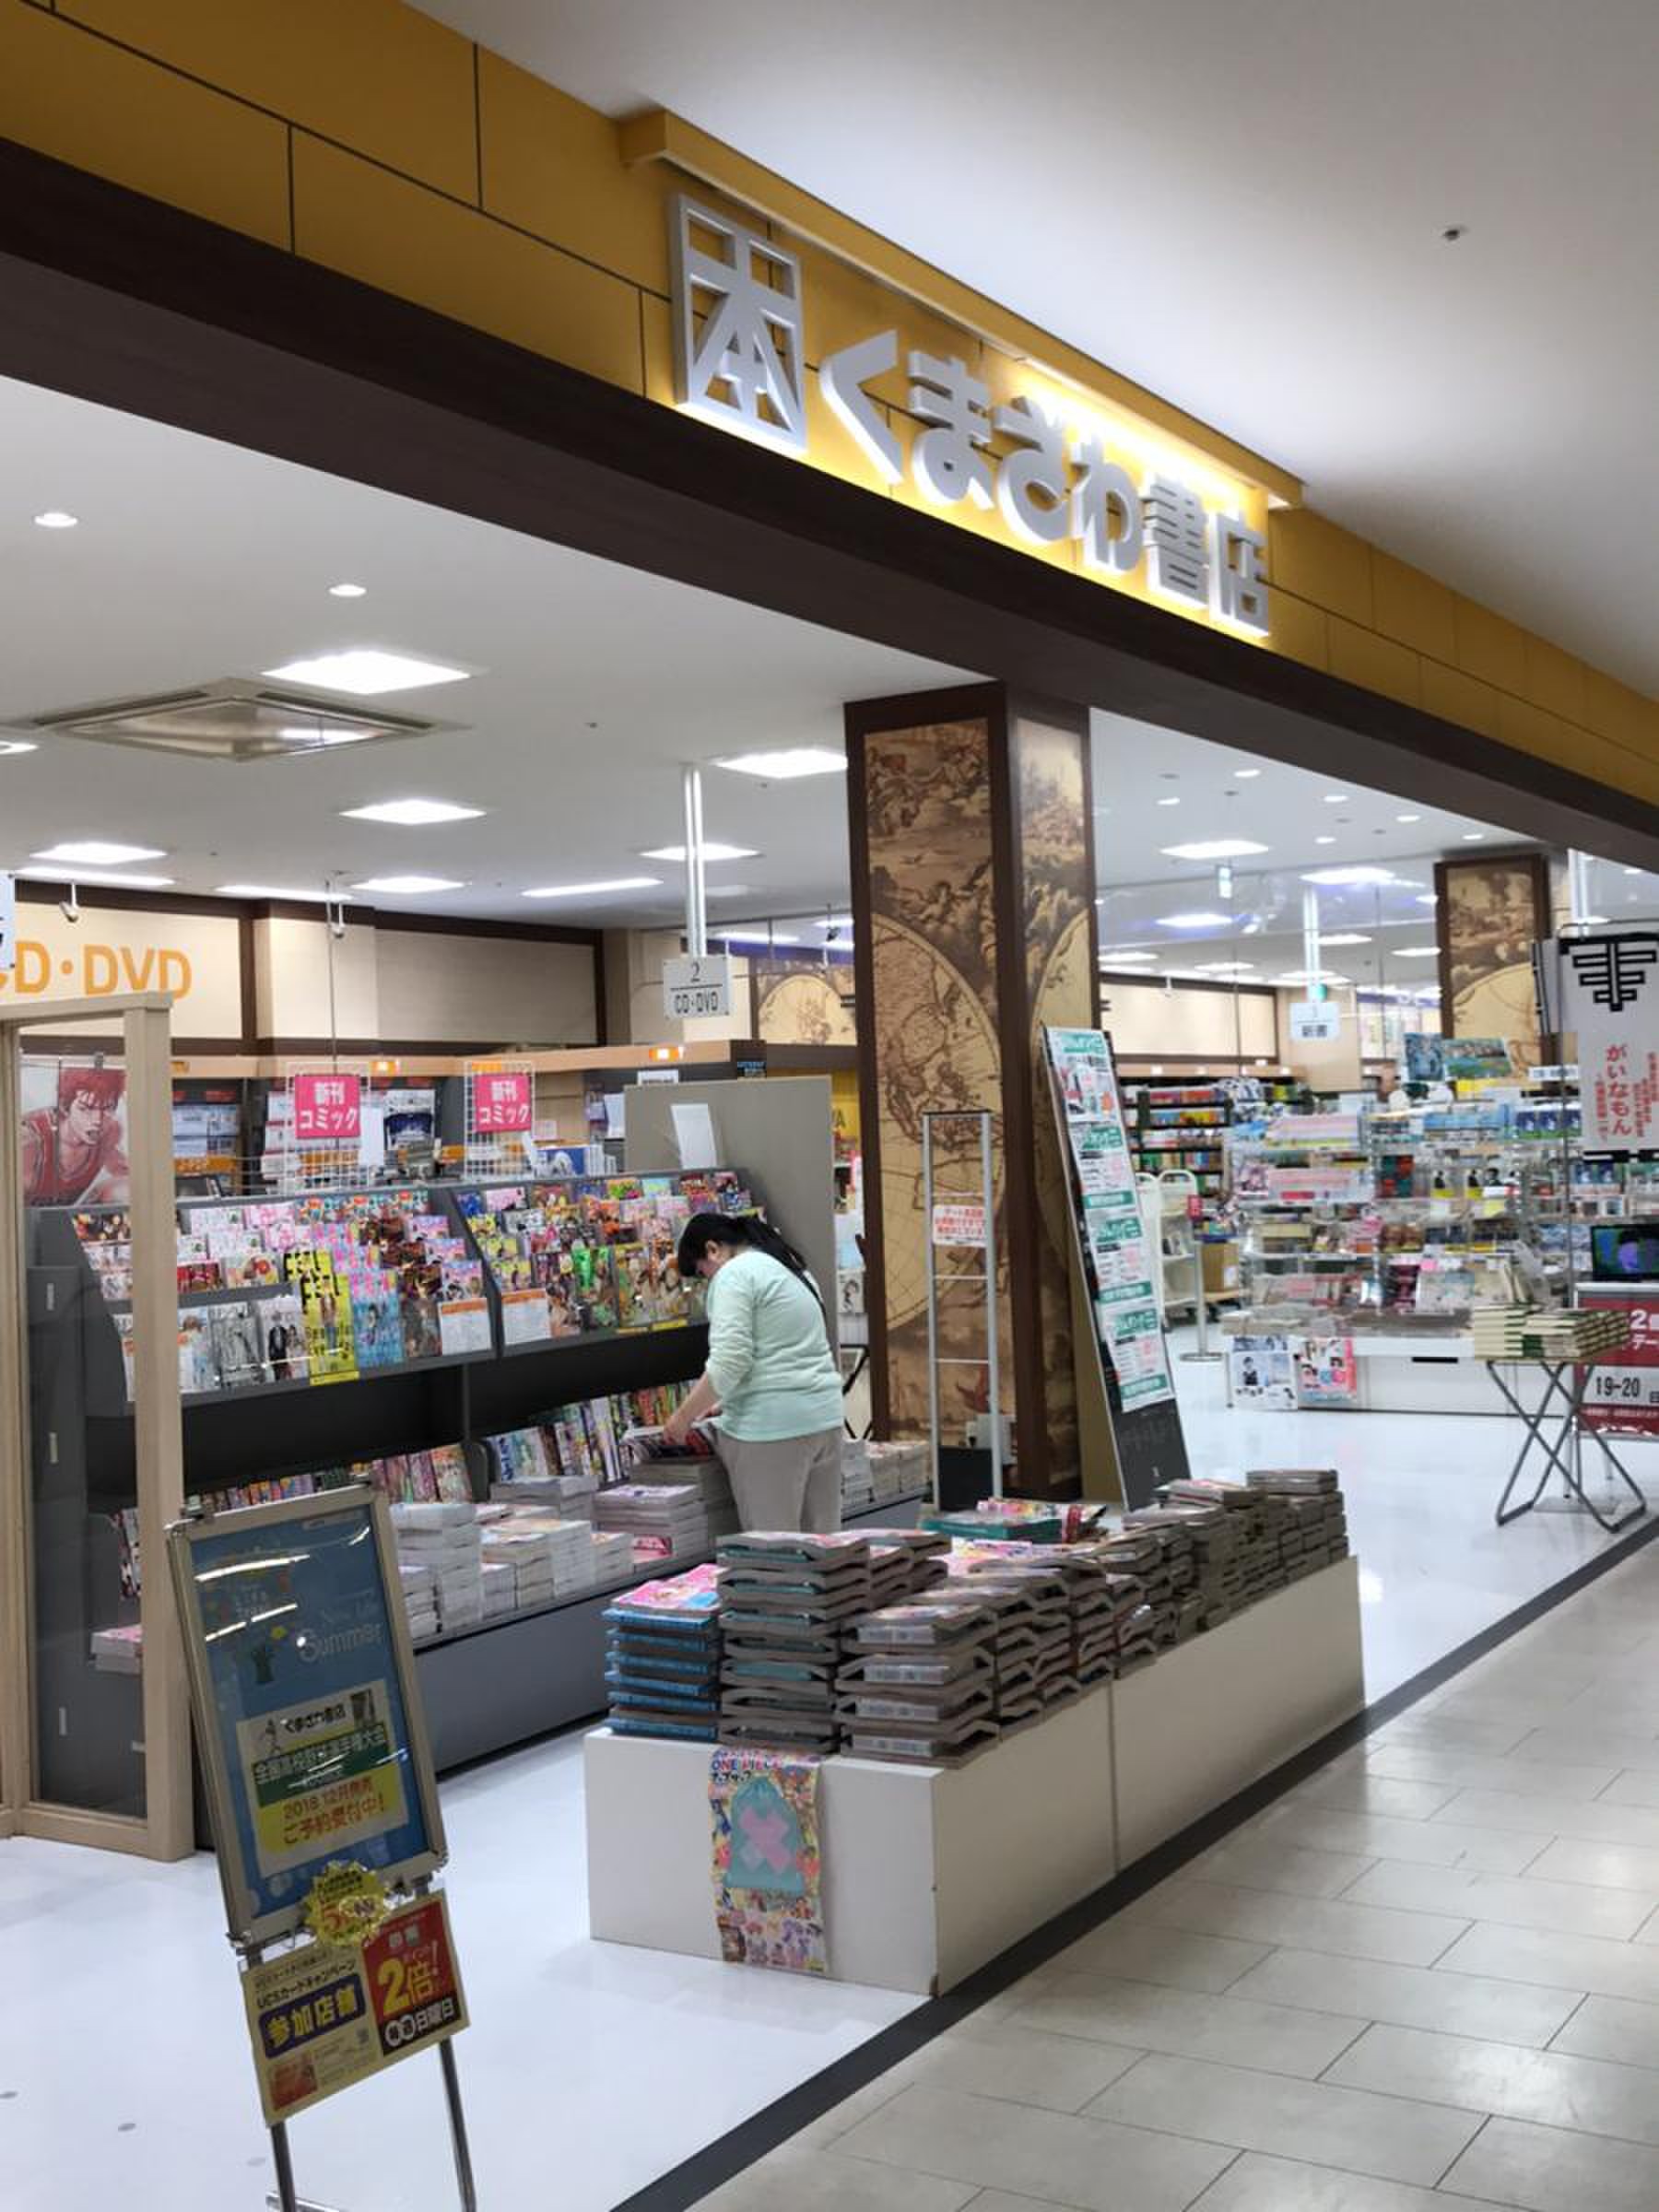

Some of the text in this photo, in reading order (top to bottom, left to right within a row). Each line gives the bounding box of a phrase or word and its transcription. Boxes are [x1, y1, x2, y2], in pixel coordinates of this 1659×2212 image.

[0, 940, 192, 1001] D・DVD
[690, 961, 700, 983] 2
[313, 1081, 346, 1106] 新刊
[489, 1080, 518, 1102] 新刊
[1606, 1043, 1631, 1135] がいなもん
[299, 1108, 359, 1131] コミック
[478, 1103, 531, 1125] コミック
